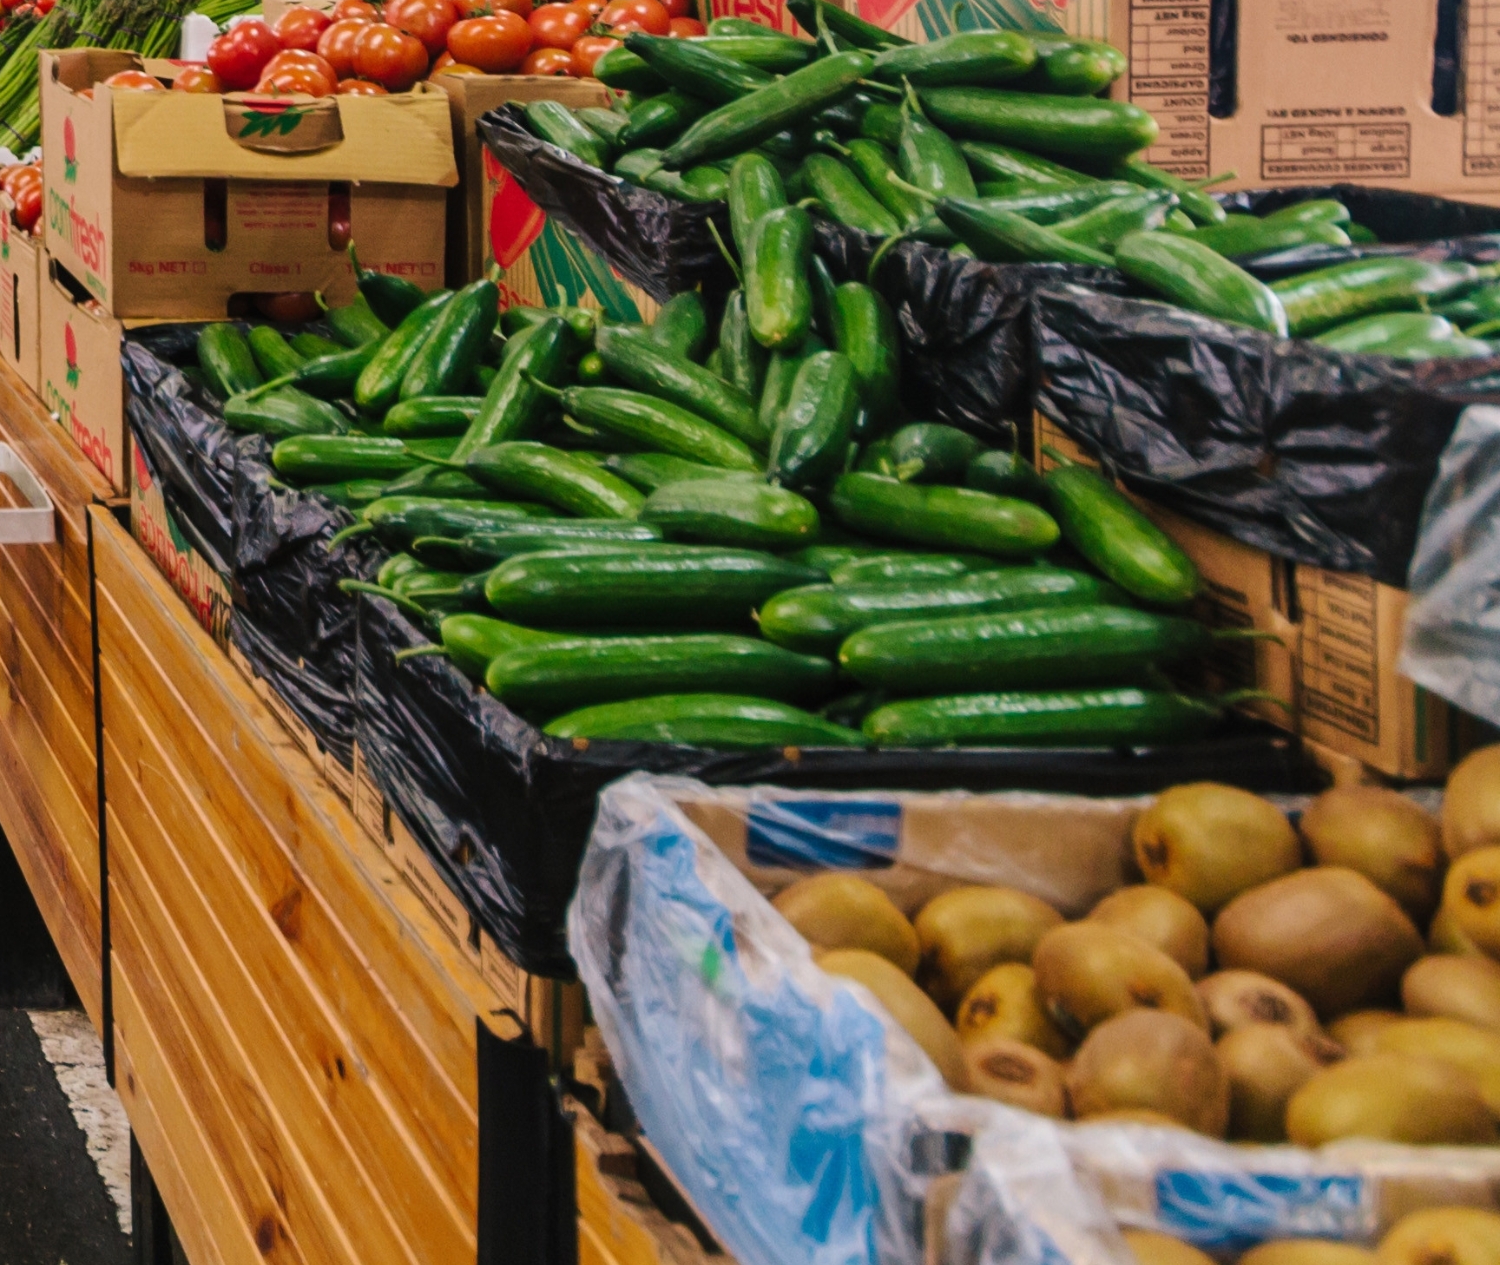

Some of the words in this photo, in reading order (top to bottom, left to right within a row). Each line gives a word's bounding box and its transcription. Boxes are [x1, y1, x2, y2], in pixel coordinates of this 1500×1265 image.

[1154, 11, 1180, 21] NET
[1182, 45, 1206, 54] Red
[1357, 107, 1406, 117] GROWN
[158, 261, 188, 275] NET
[248, 261, 292, 275] Class
[385, 261, 417, 276] NET
